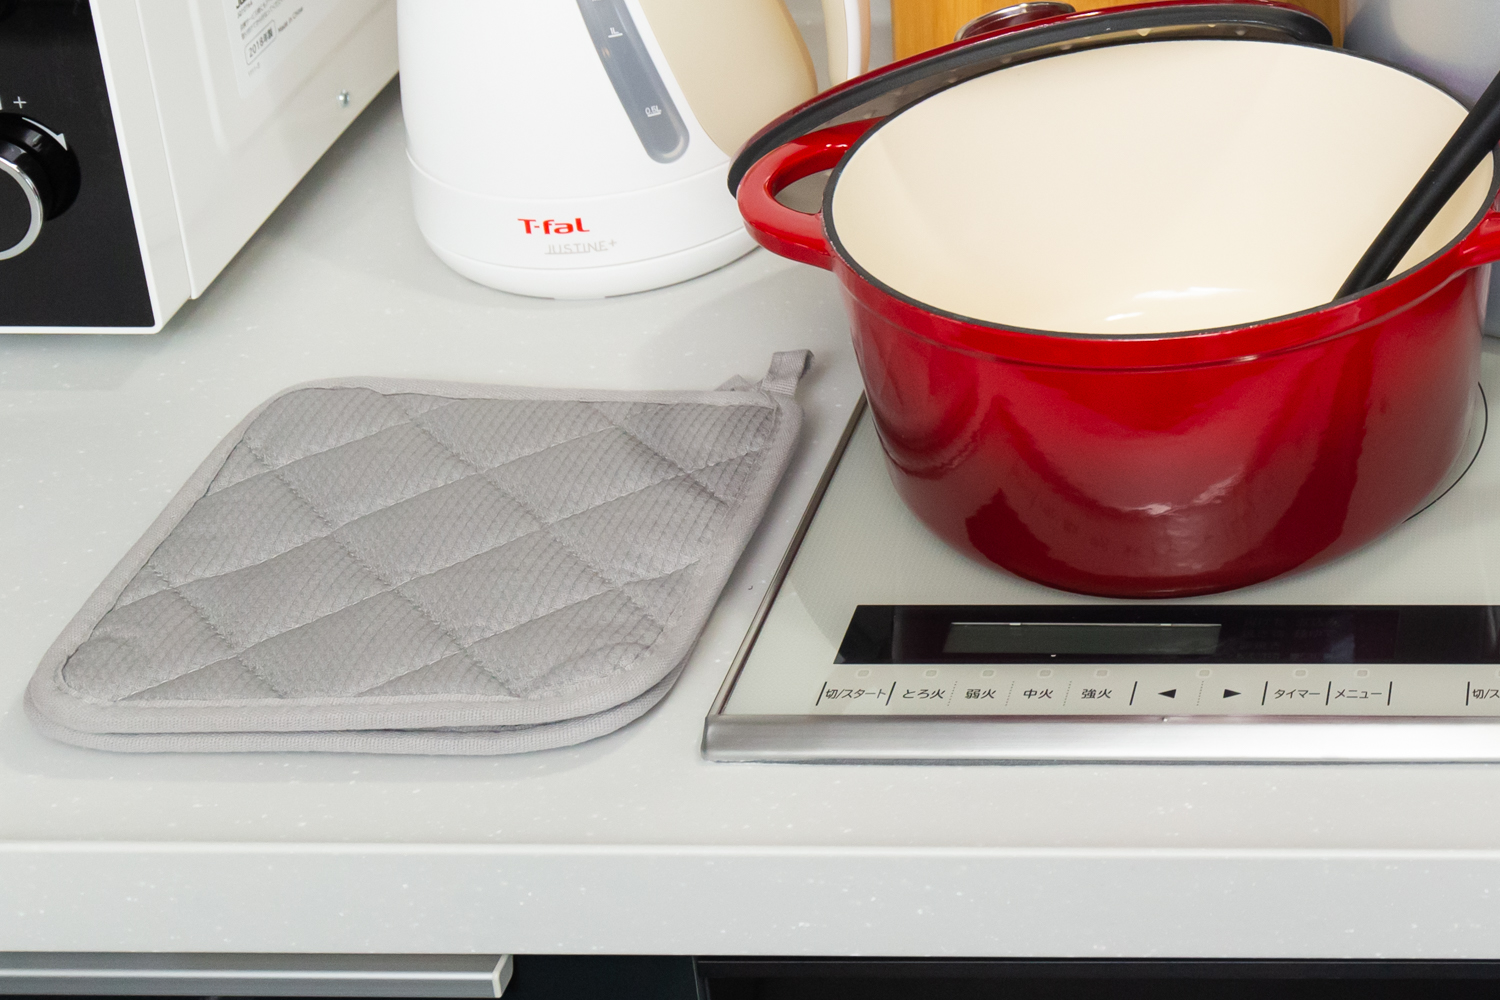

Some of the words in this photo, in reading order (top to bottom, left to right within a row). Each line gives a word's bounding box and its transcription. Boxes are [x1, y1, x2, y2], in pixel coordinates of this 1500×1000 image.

[517, 218, 590, 235] T-fal
[826, 688, 886, 700] 切/スタート
[903, 688, 945, 700] とろ火
[965, 688, 996, 700] 弱火
[1023, 688, 1053, 700] 中火
[1081, 688, 1113, 700] 強火
[1274, 688, 1320, 700] タイマー
[1334, 688, 1382, 700] メニュー
